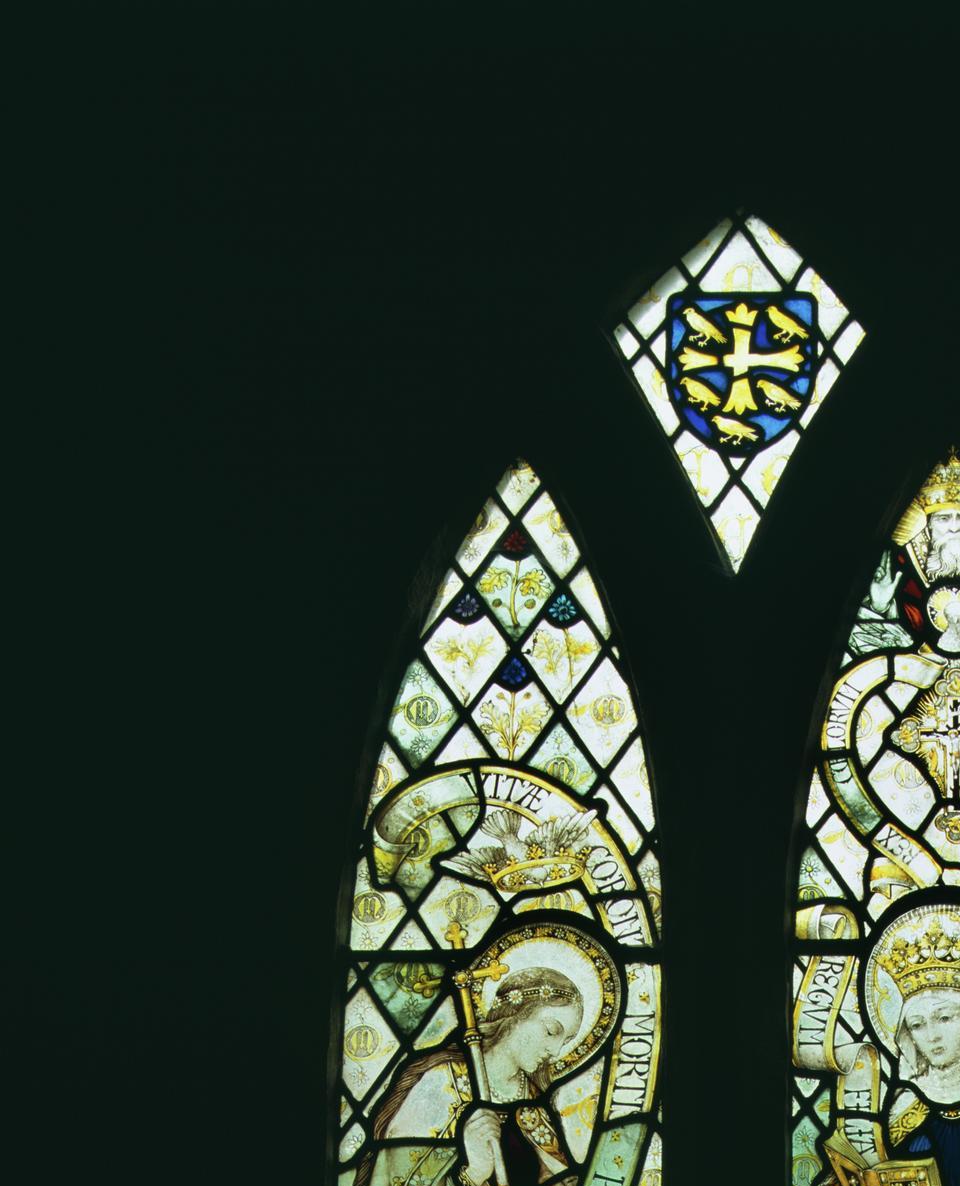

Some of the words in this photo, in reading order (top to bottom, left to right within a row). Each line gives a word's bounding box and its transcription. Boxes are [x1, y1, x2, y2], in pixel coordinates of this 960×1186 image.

[459, 772, 552, 815] VITÆ
[876, 826, 921, 865] REX
[589, 845, 648, 944] CORON
[798, 958, 846, 1047] REGVM
[610, 1010, 656, 1115] MORTI
